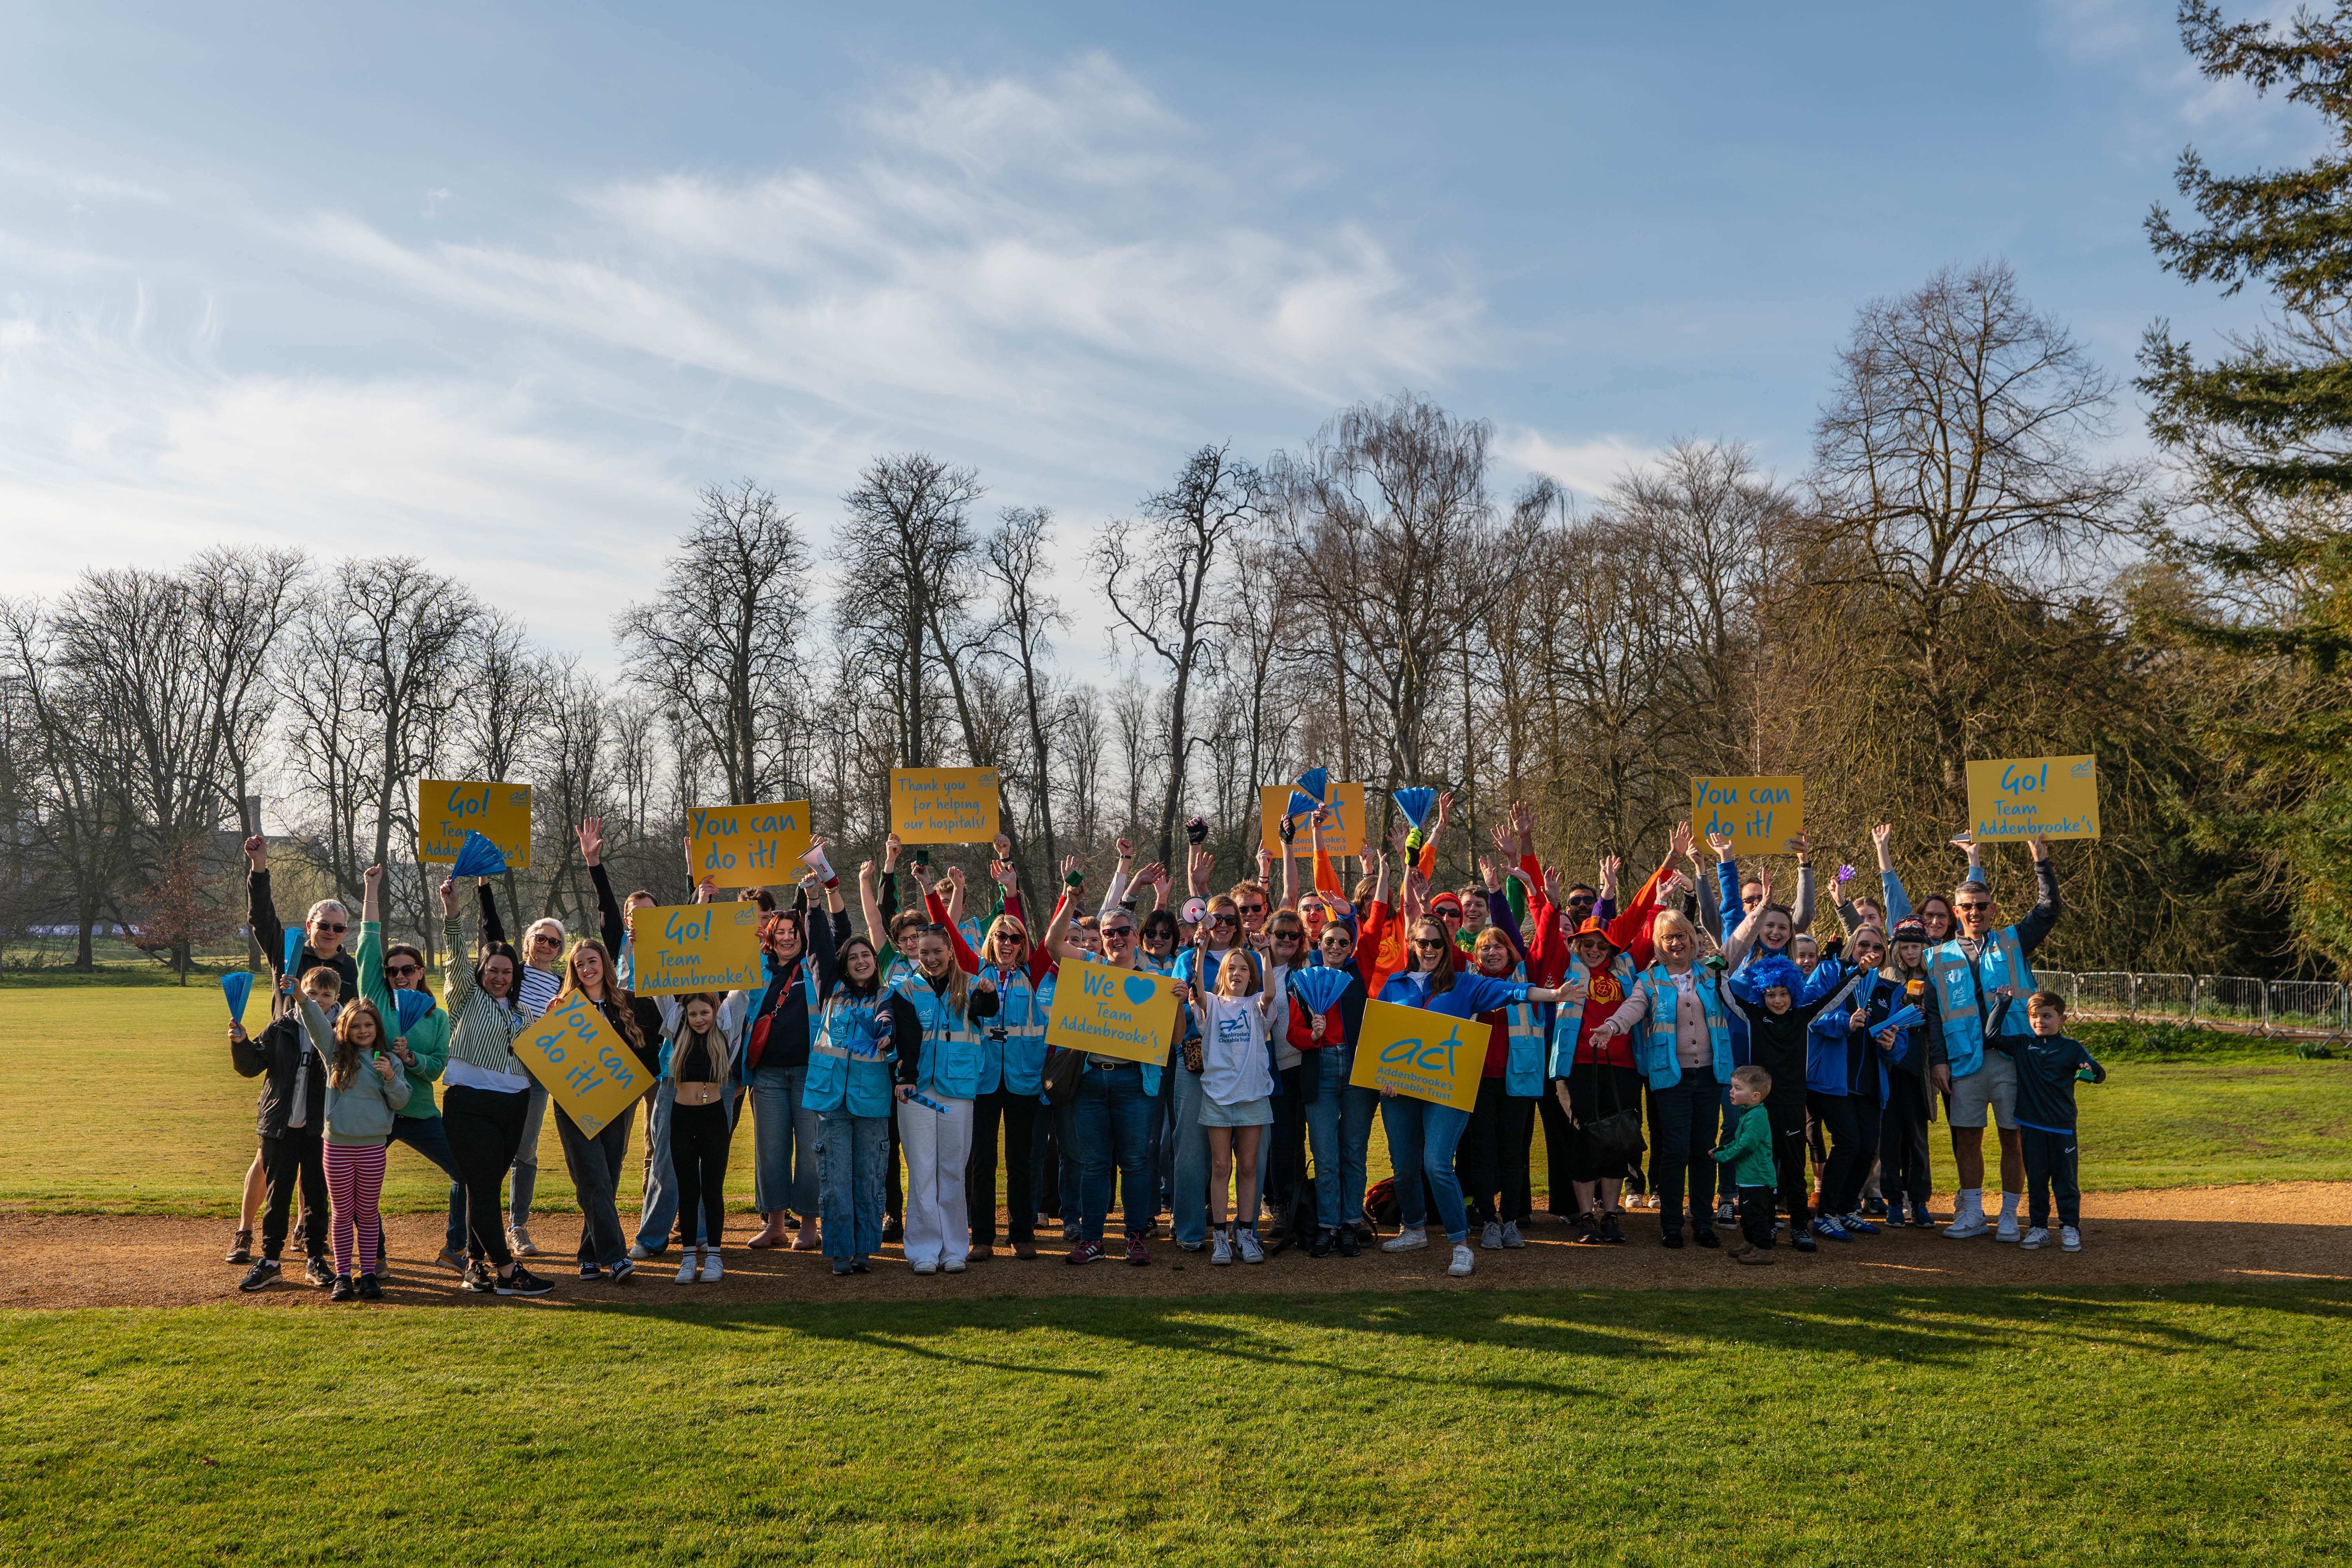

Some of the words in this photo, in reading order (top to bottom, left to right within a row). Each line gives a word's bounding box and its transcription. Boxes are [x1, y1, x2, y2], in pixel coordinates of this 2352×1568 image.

[2071, 757, 2092, 772] act
[978, 769, 996, 782] act
[2001, 763, 2047, 796] Go!
[510, 787, 529, 800] act
[898, 778, 939, 792] Thank
[944, 782, 966, 797] you
[1696, 780, 1738, 809] You
[1749, 788, 1790, 805] can
[447, 786, 490, 818] Go!
[913, 797, 932, 816] for
[936, 796, 980, 815] helping
[1993, 800, 2037, 816] Team
[692, 809, 739, 840] You
[750, 815, 796, 833] can
[904, 820, 924, 830] our
[929, 815, 985, 835] hospitals!
[1705, 809, 1735, 837] do
[1746, 809, 1773, 839] it!
[1978, 815, 2093, 837] Addenbrooke's
[424, 840, 524, 862] Addeke's
[463, 834, 472, 849] TEAM
[705, 842, 737, 870] do
[748, 838, 777, 869] it!
[819, 863, 828, 874] PYLE
[734, 903, 756, 919] act
[665, 910, 712, 946] Go!
[657, 949, 701, 968] Team
[641, 965, 755, 991] Addenbrooke's
[1083, 969, 1114, 998] We
[1292, 977, 1301, 991] TEAM
[919, 1007, 932, 1016] act
[1096, 1002, 1132, 1023] Team
[1220, 1007, 1249, 1032] act
[832, 1024, 845, 1033] act
[1058, 1015, 1158, 1048] Addenbrooke's
[554, 994, 599, 1045] You
[598, 1047, 634, 1090] can
[1379, 1024, 1463, 1077] act
[535, 1030, 566, 1063] do
[565, 1060, 604, 1098] it!
[1376, 1066, 1453, 1091] Addenbrooke's
[1427, 1087, 1451, 1101] Trust
[582, 1114, 605, 1132] act
